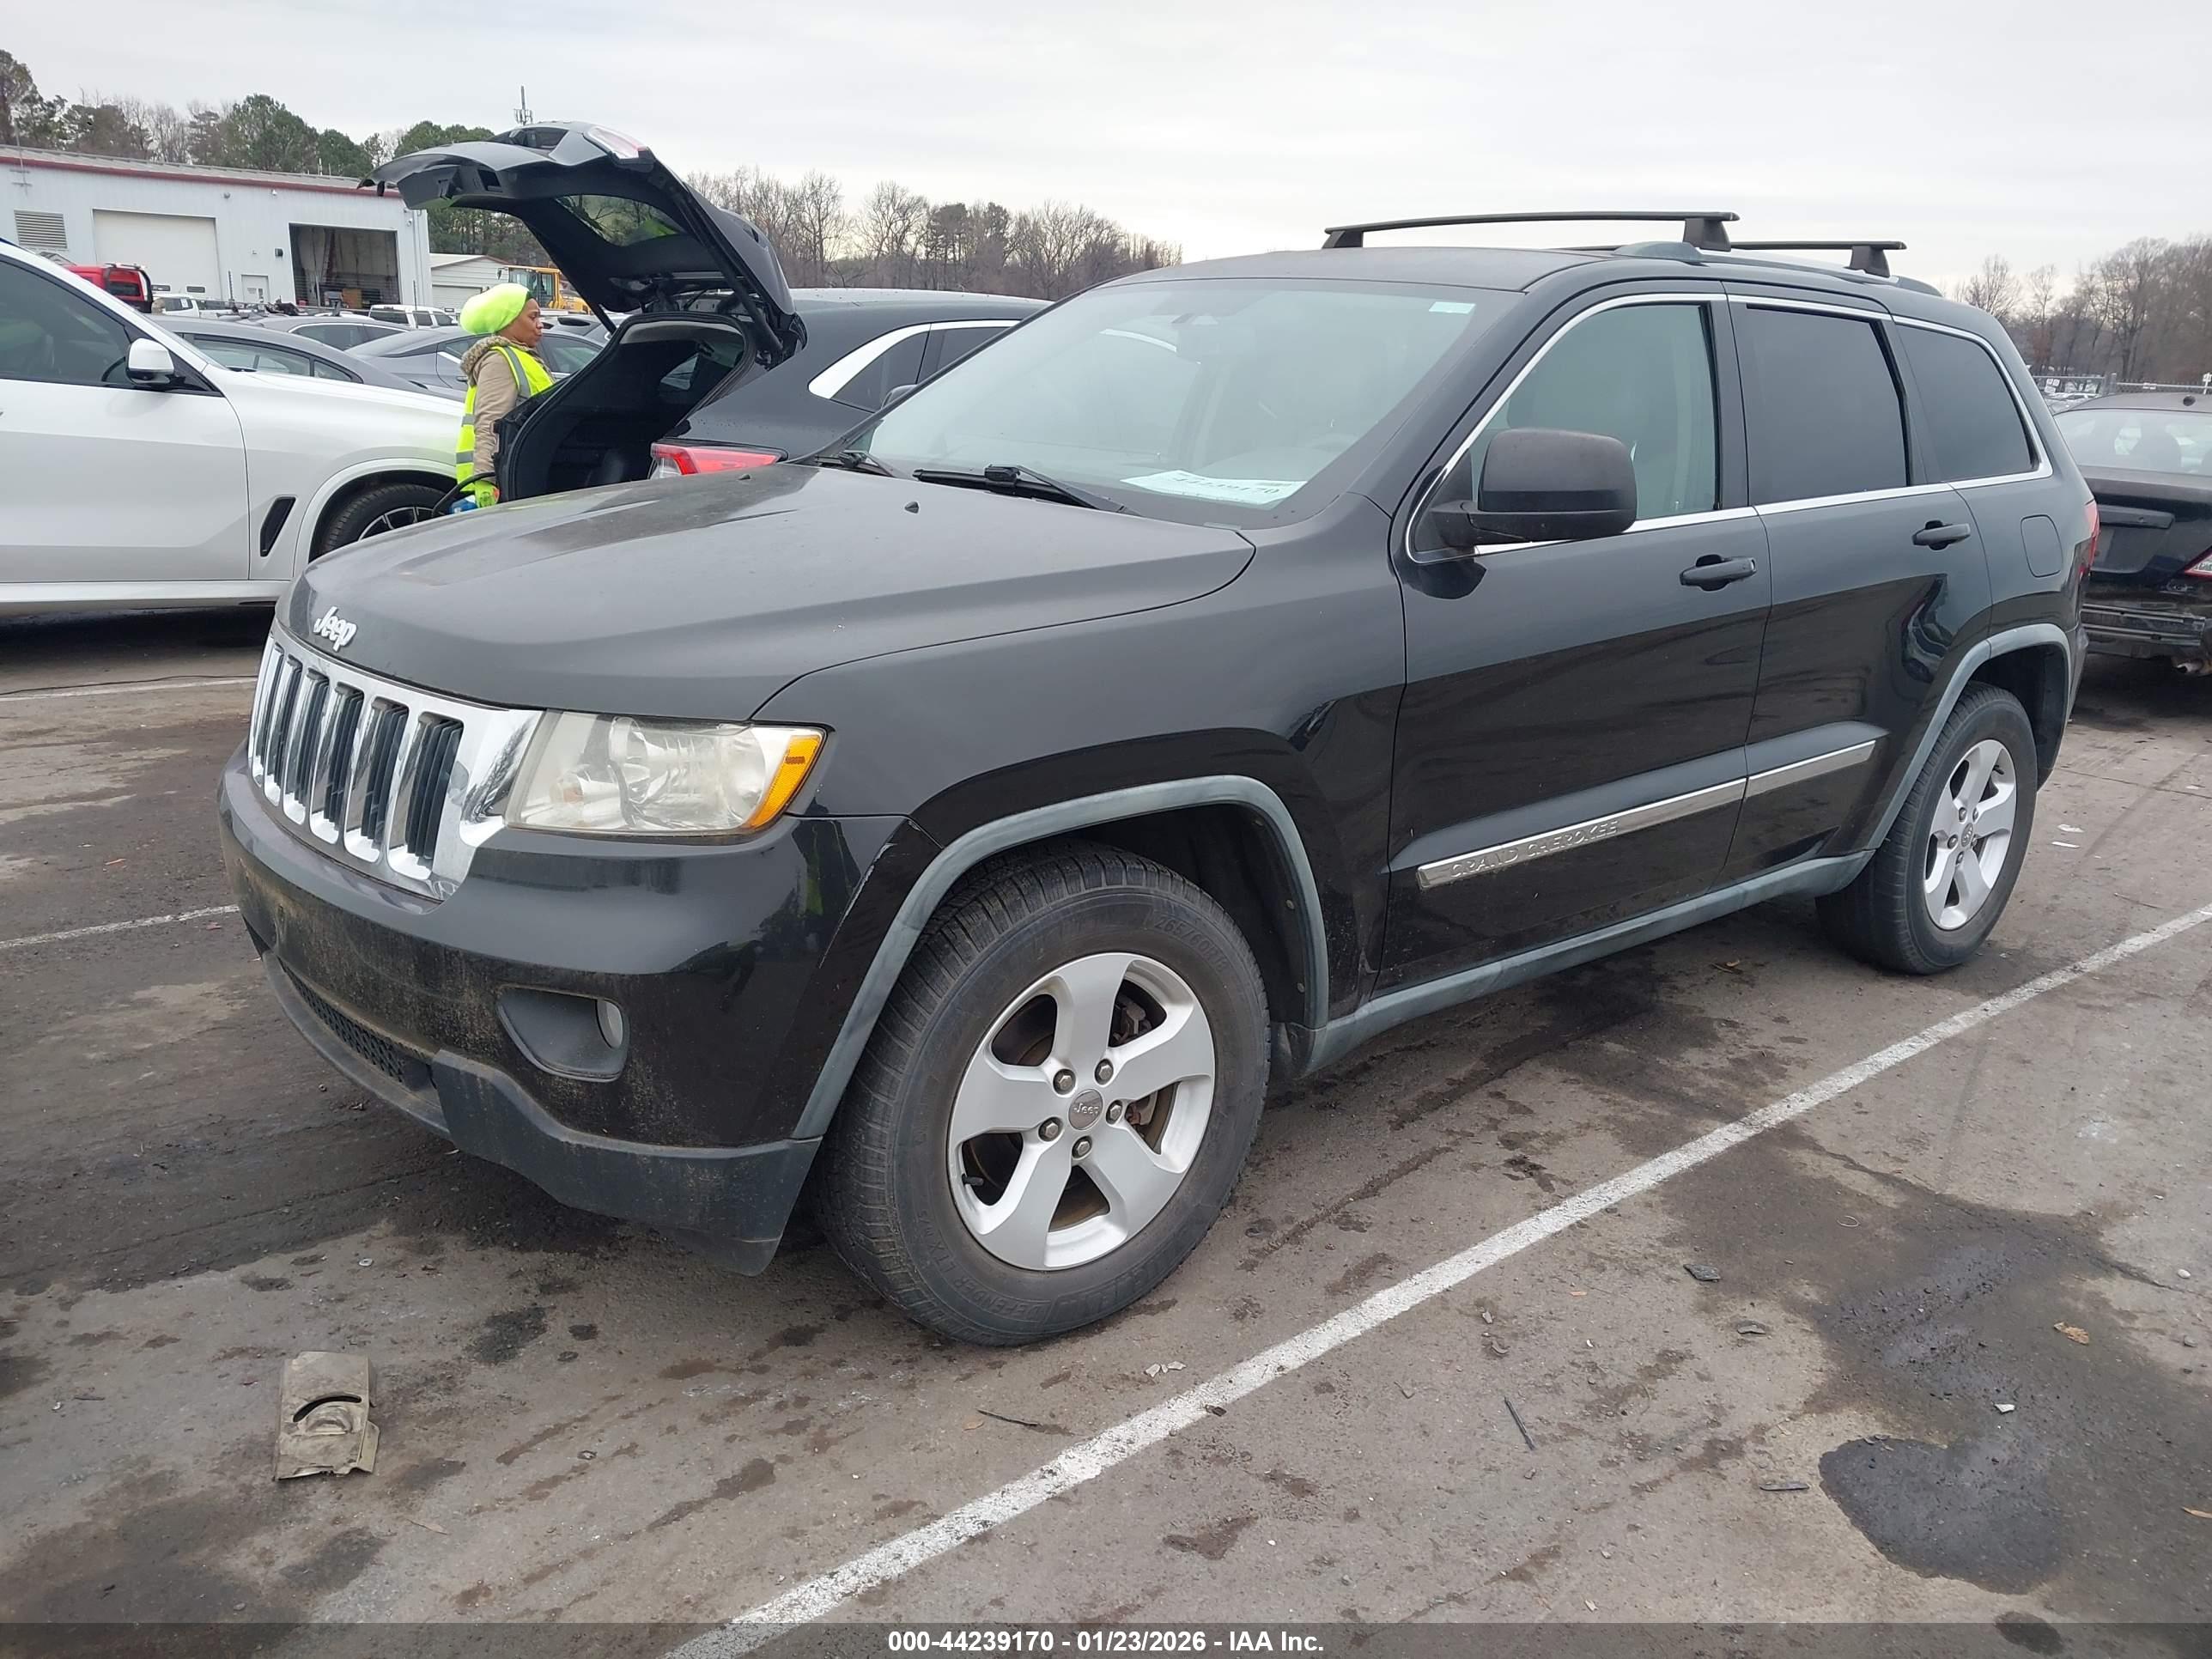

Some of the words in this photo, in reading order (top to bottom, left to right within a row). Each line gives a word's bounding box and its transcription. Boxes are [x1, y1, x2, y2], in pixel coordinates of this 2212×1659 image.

[313, 605, 357, 652] Jeep
[1451, 847, 1518, 877] GRAND
[1528, 821, 1618, 857] CHEROKEE
[1073, 1103, 1098, 1116] Jeep
